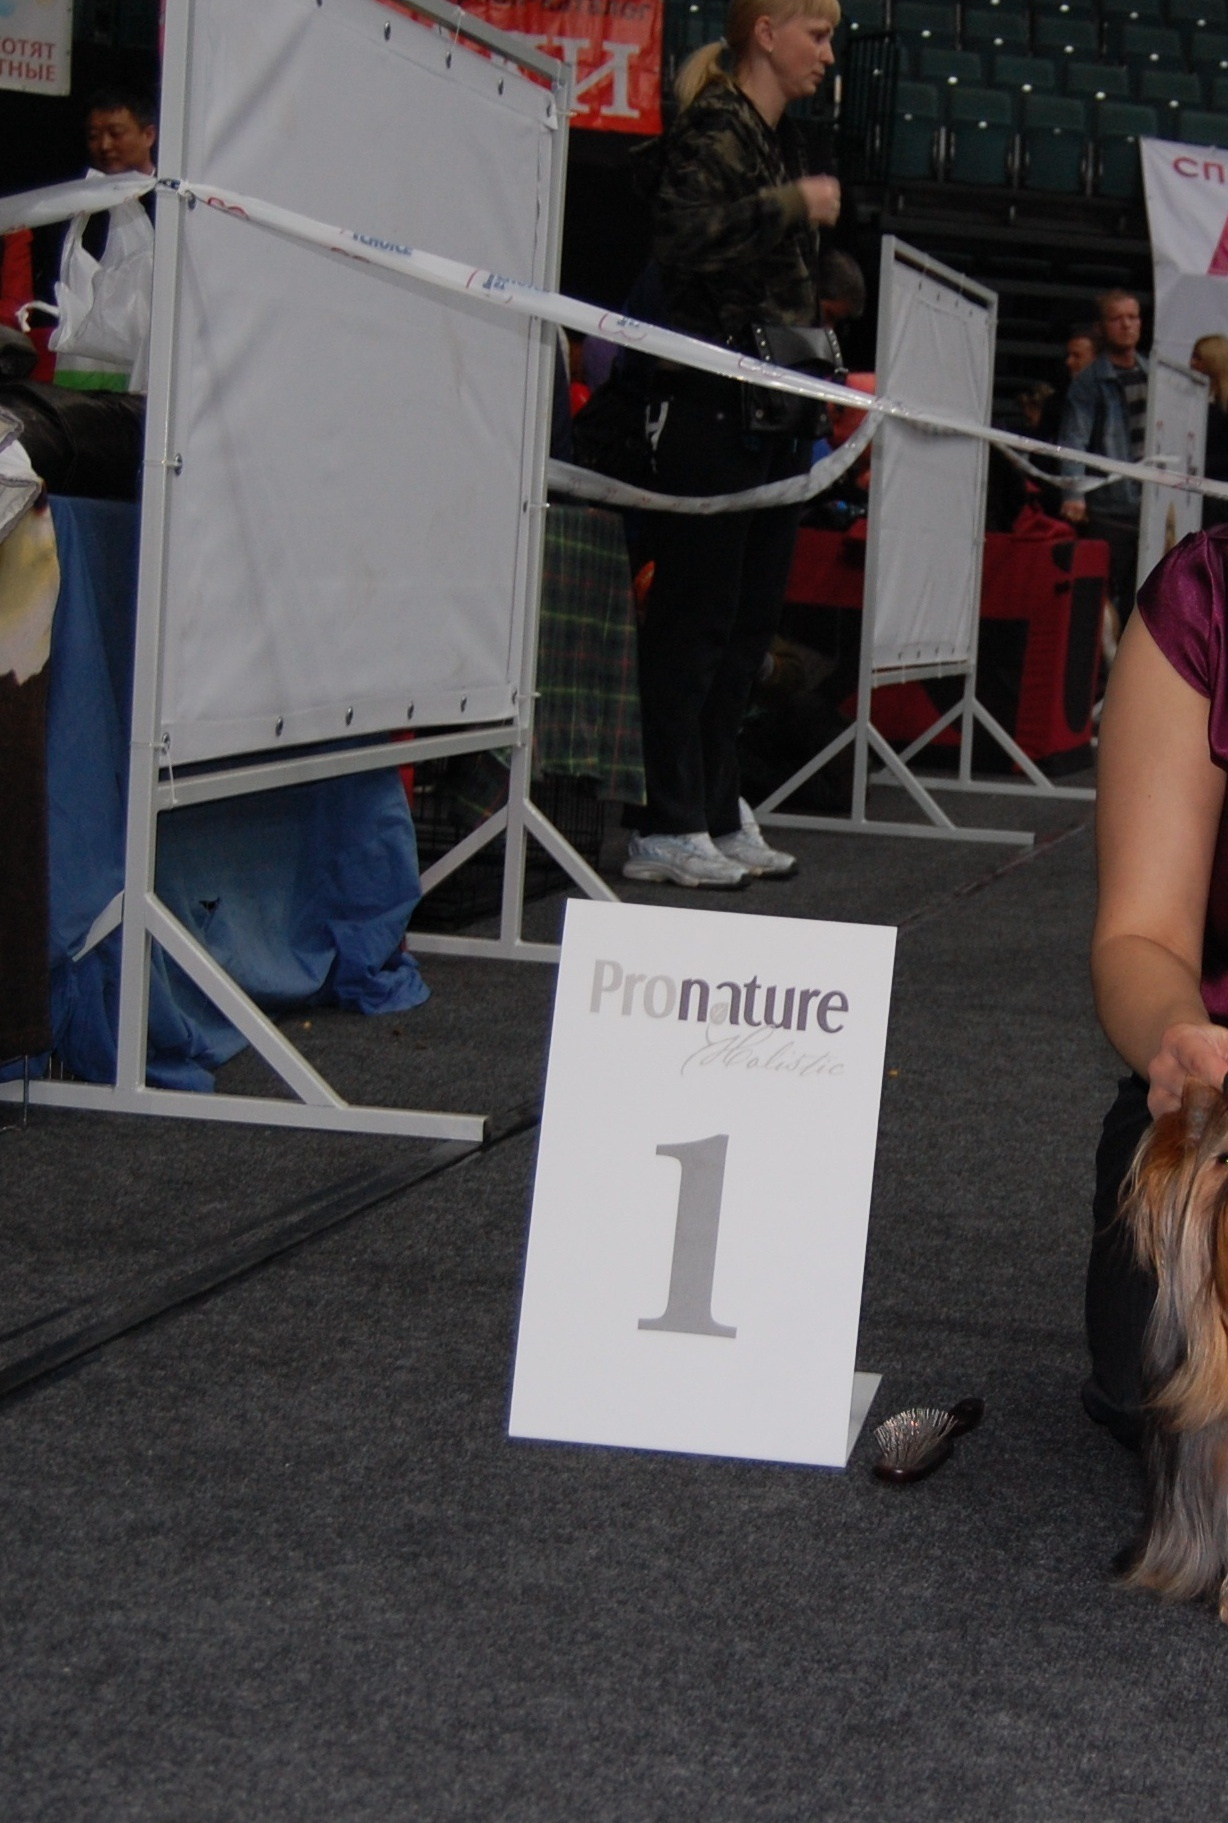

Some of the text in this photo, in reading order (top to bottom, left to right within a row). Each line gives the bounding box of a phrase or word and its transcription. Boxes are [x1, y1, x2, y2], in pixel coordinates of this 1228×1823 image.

[1, 37, 56, 59] ОТЯТ
[589, 958, 850, 1035] Pronature
[680, 1024, 846, 1078] Holistic
[637, 1133, 738, 1340] 1
